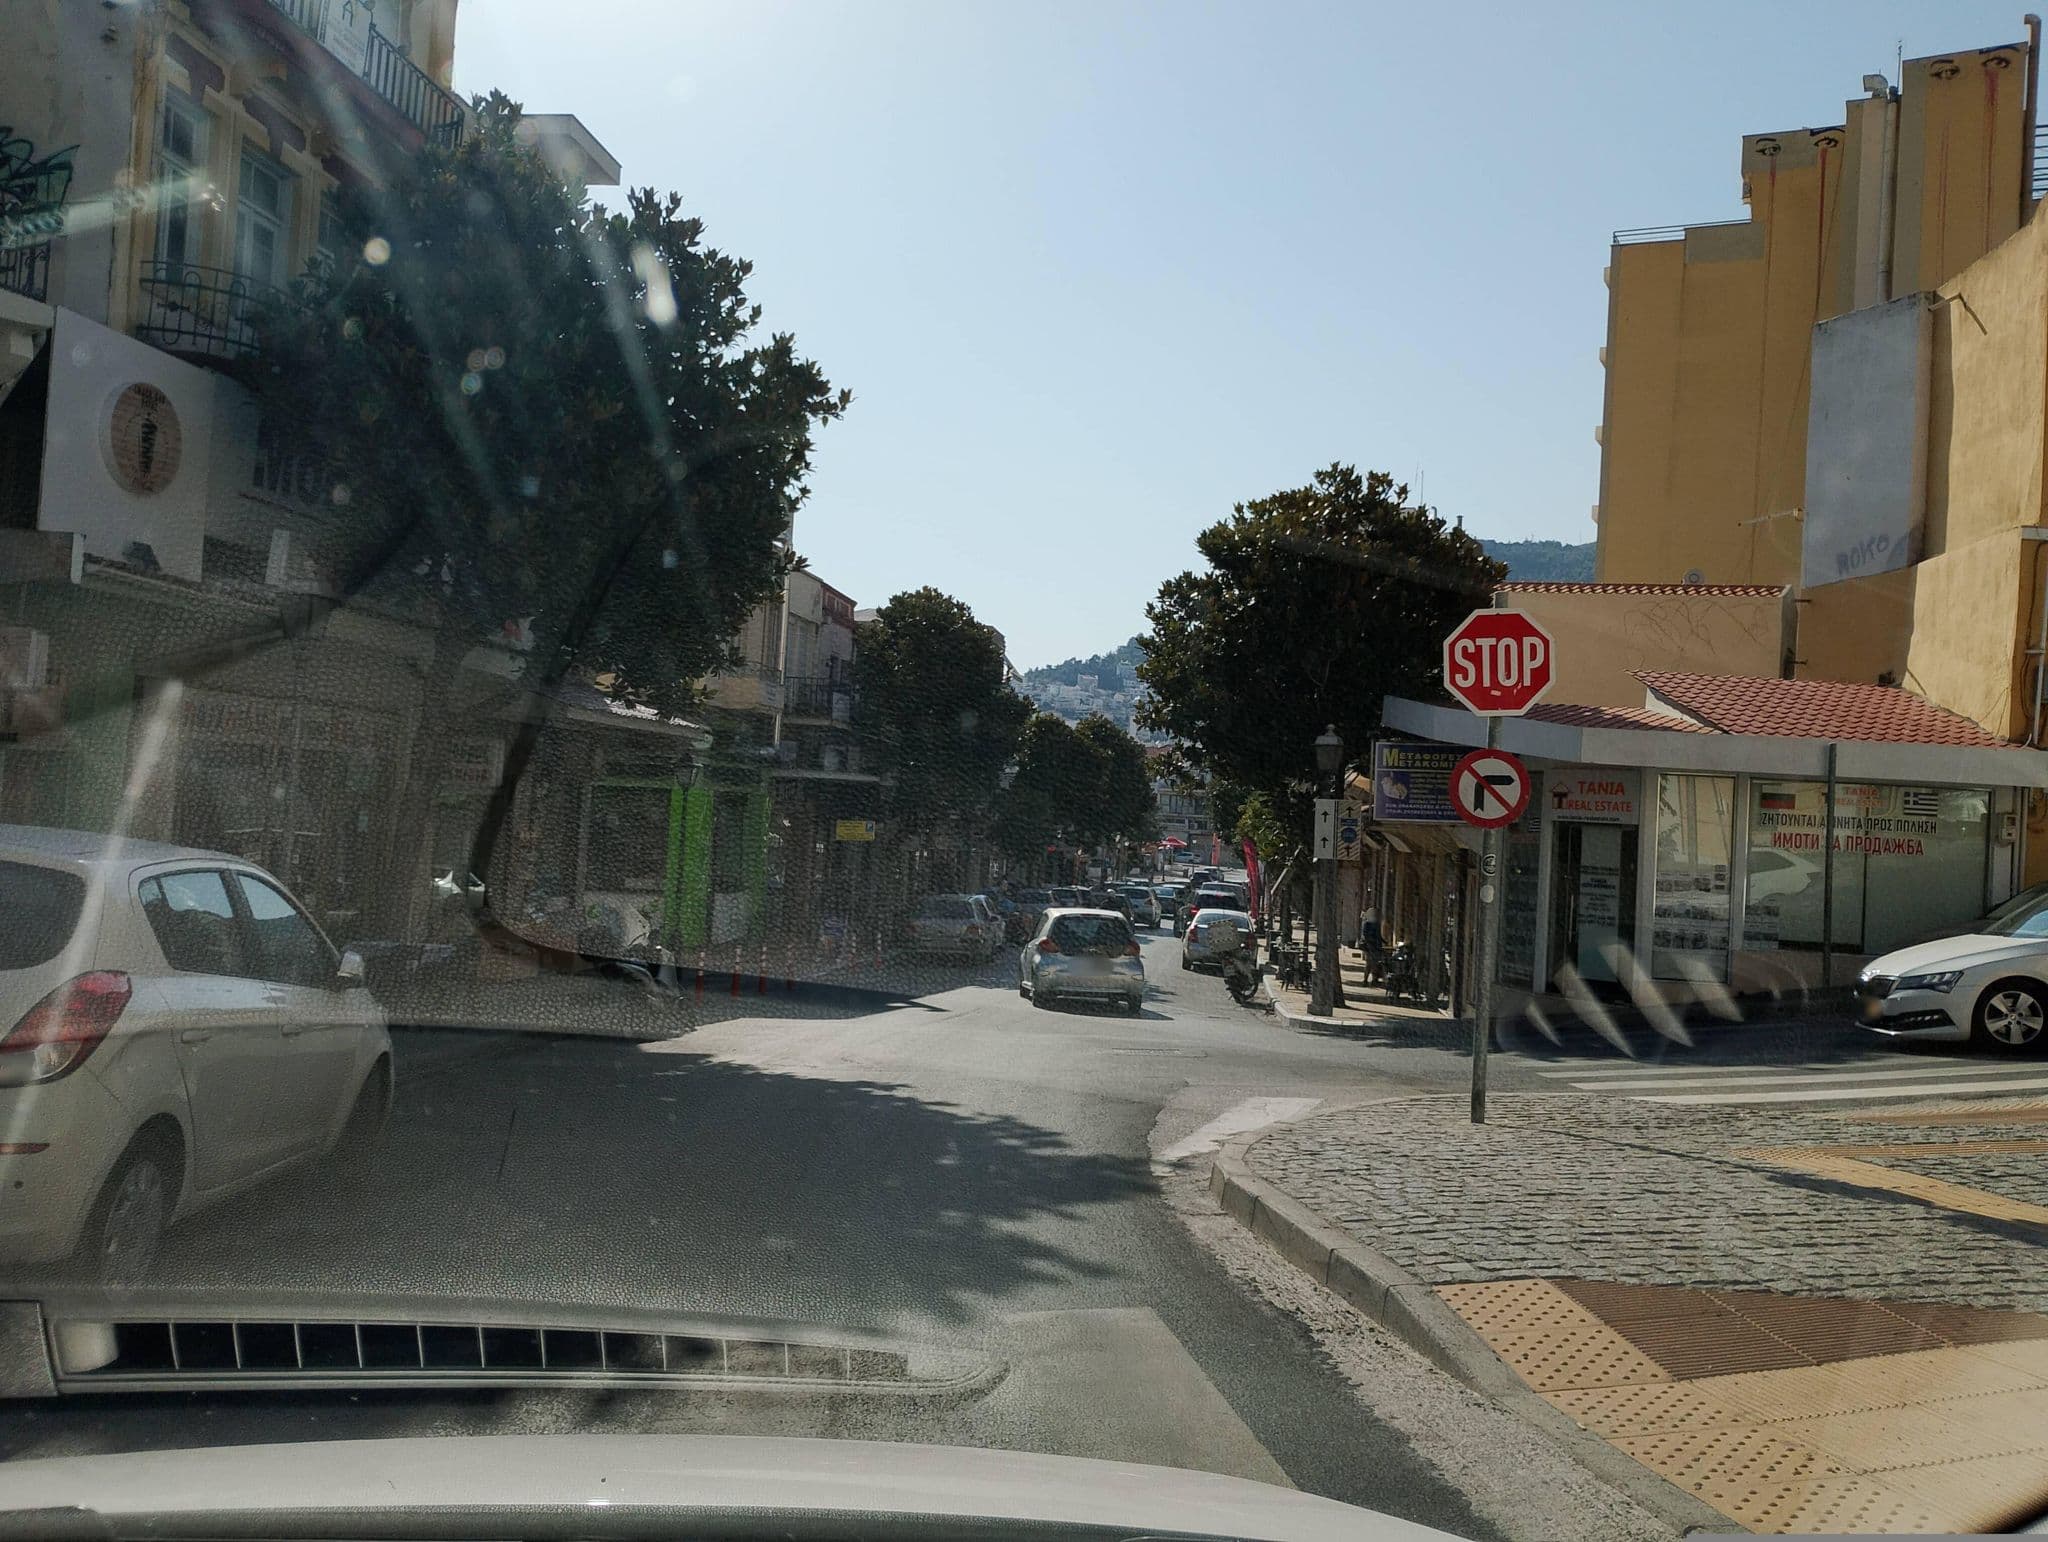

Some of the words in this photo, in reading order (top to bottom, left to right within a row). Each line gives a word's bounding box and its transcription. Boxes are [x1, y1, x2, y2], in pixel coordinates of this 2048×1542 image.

[1454, 636, 1545, 688] STOP
[1578, 781, 1625, 796] TANIA
[1567, 800, 1593, 811] REAL
[1595, 800, 1633, 812] ESTATE
[1762, 812, 1816, 829] ΖΗΤΟΥΝΤΑΙ
[1866, 818, 1893, 832] ΠΡΟΣ
[1773, 832, 1820, 850] ИМОТИ
[1845, 836, 1925, 856] ПРОДАЖБА
